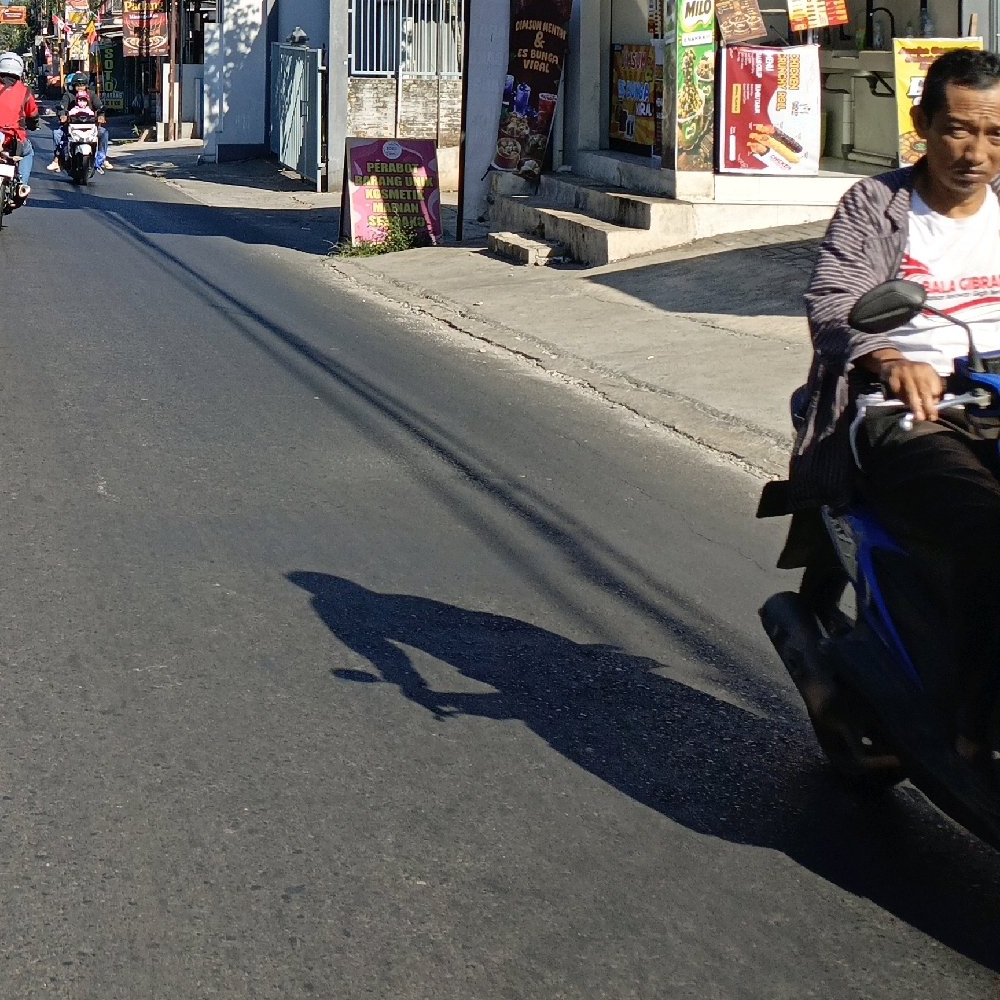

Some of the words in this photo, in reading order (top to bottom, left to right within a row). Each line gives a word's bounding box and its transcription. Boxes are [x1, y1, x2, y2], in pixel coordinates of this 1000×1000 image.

[685, 0, 712, 20] MILO
[534, 31, 546, 49] &
[517, 48, 528, 58] ES
[530, 49, 559, 65] BUNGA
[523, 59, 550, 74] VIRAL
[788, 53, 801, 91] CHICKEN
[775, 91, 787, 111] ROLL
[367, 162, 419, 173] PERABOT
[354, 175, 403, 187] BARANG
[405, 176, 434, 187] UNIK
[365, 189, 425, 200] KOSMETIK
[959, 274, 1000, 291] GIBRA
